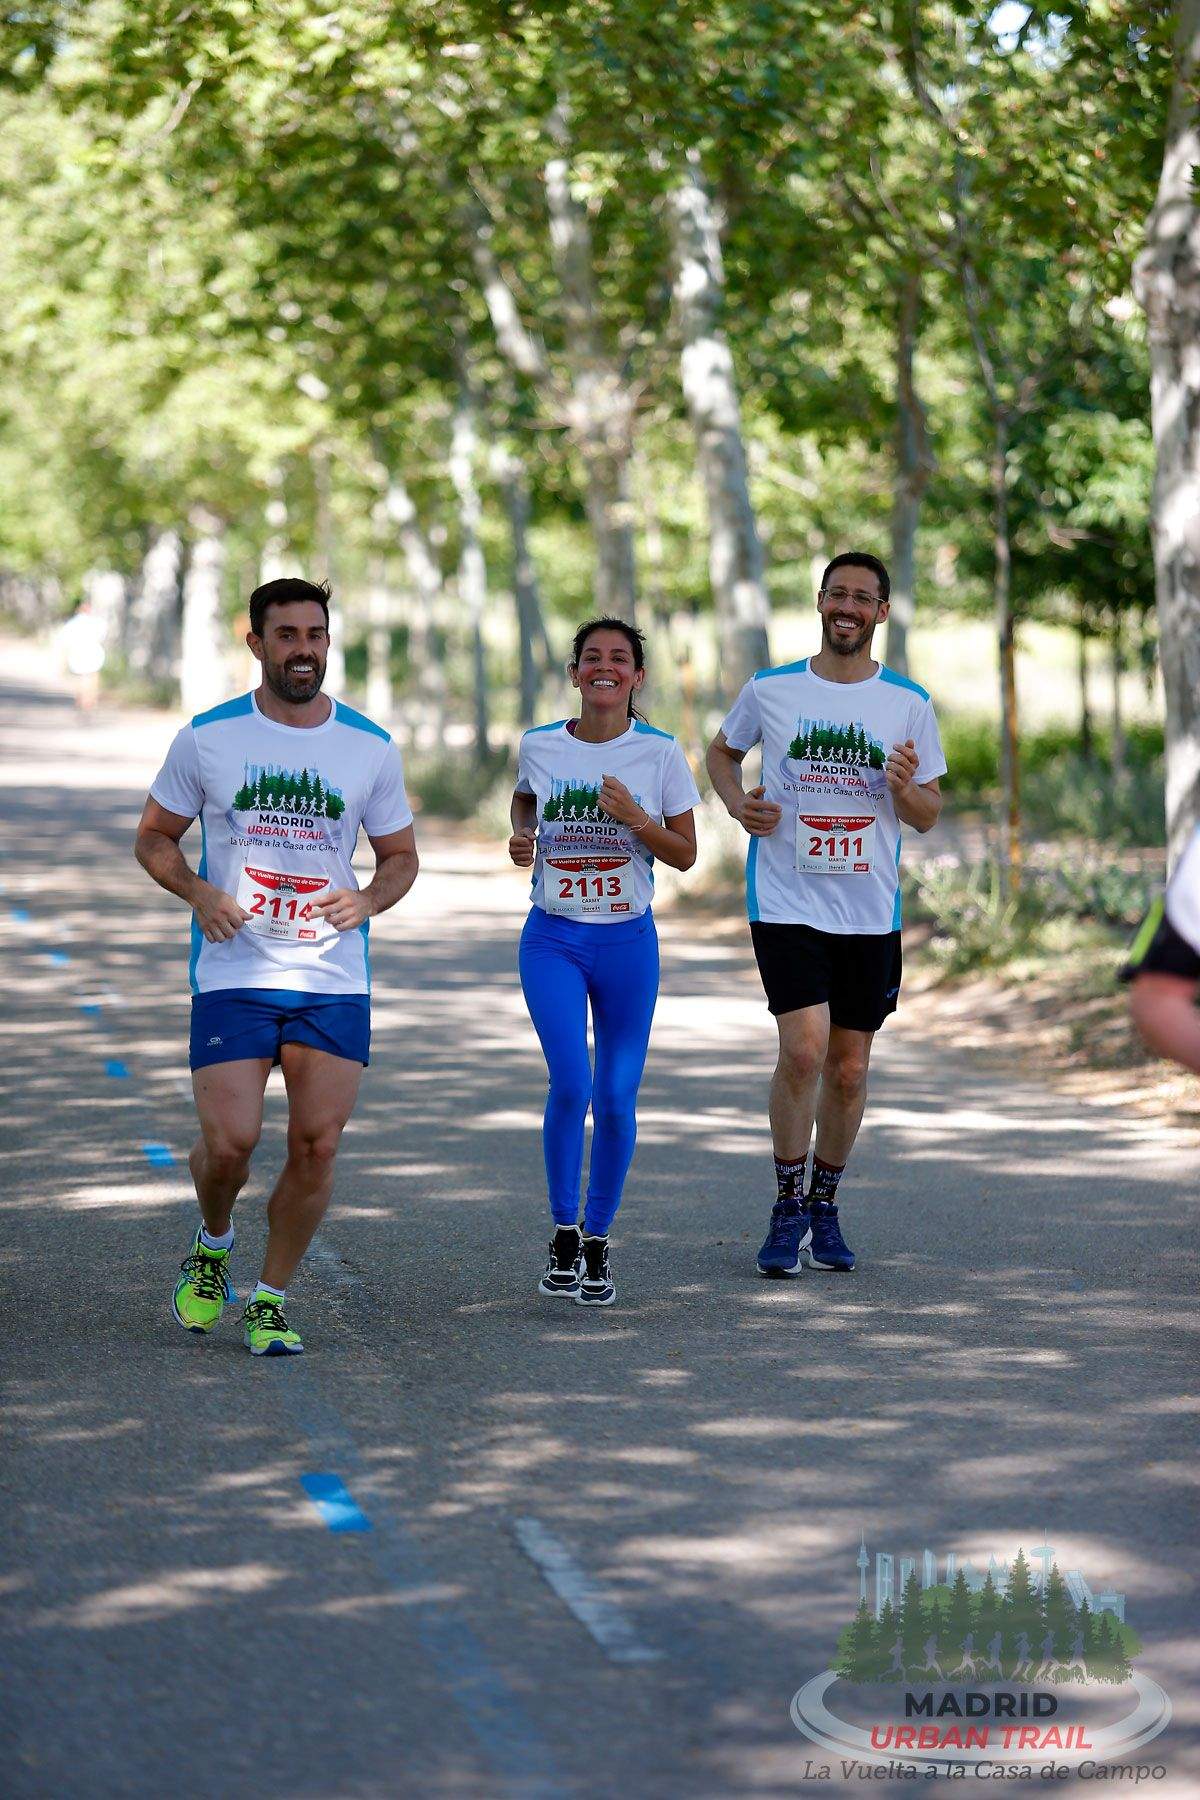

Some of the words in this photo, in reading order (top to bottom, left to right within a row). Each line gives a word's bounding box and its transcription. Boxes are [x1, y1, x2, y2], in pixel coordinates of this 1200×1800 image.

[811, 764, 859, 776] MADRID
[800, 774, 838, 784] URBAN
[842, 778, 868, 789] TRAIL
[783, 783, 790, 791] La
[793, 784, 814, 793] Vuelta
[833, 788, 852, 796] Casa
[855, 789, 864, 797] de
[259, 814, 314, 828] MADRID
[248, 826, 288, 837] URBAN
[292, 830, 326, 840] TRAIL
[564, 825, 618, 836] MADRID
[239, 838, 262, 846] Vuelta
[272, 839, 280, 848] la
[283, 841, 304, 850] Casa
[306, 843, 317, 851] de
[547, 844, 570, 852] Vuelta
[554, 836, 593, 844] URBAN
[598, 837, 628, 846] TRAIL
[809, 837, 862, 856] 2111
[258, 870, 274, 880] Vuelta
[559, 877, 621, 898] 2113
[250, 893, 313, 922] 2114
